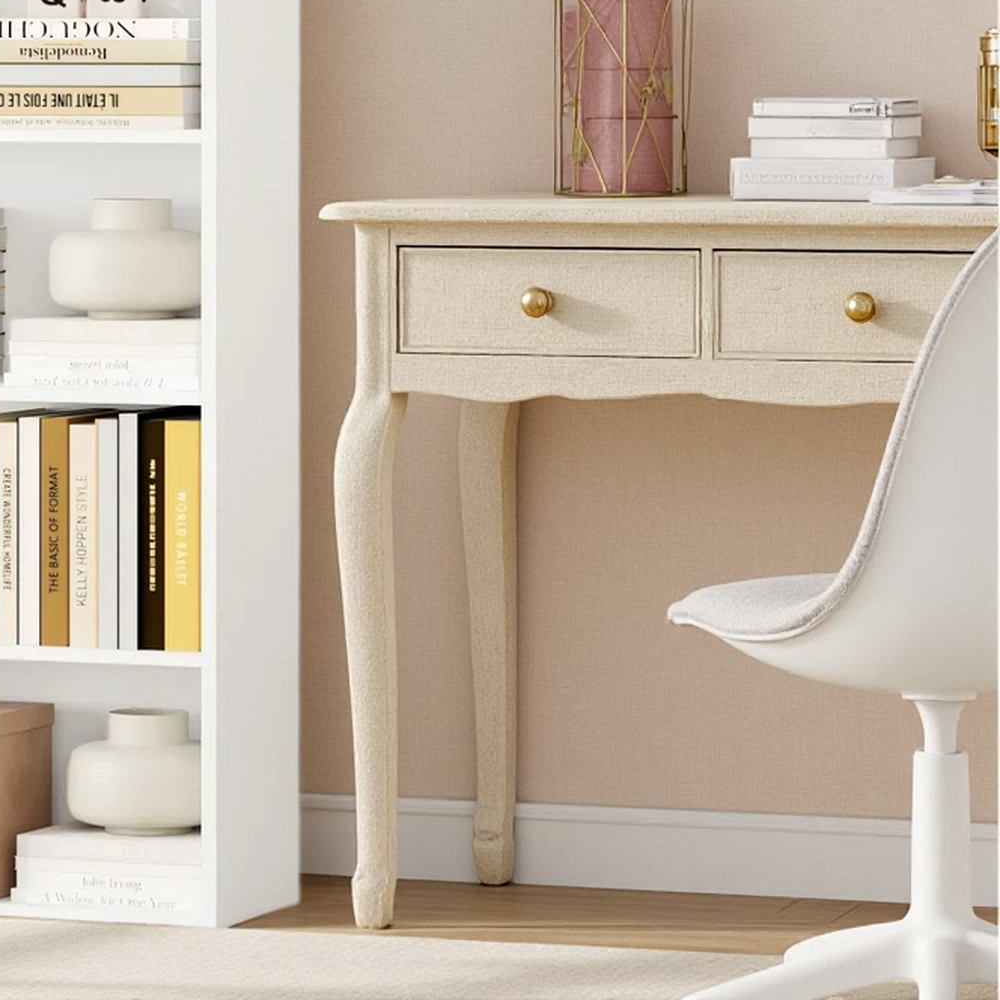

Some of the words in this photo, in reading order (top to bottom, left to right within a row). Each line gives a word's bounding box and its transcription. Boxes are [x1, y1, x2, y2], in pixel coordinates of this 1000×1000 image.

[19, 46, 107, 60] Remodelista
[8, 93, 21, 107] LE
[23, 93, 48, 107] FOIS
[51, 93, 73, 107] UNE
[76, 93, 106, 111] ÉTAIT
[109, 93, 119, 107] IL
[2, 468, 12, 497] CREATE
[48, 466, 59, 513] FORMAT
[75, 474, 87, 511] STYLE
[176, 491, 187, 536] WORLD
[48, 517, 59, 532] OF
[75, 516, 87, 566] HOPPEN
[48, 537, 59, 569] BASIC
[48, 572, 59, 593] THE
[75, 569, 87, 606] KELLY
